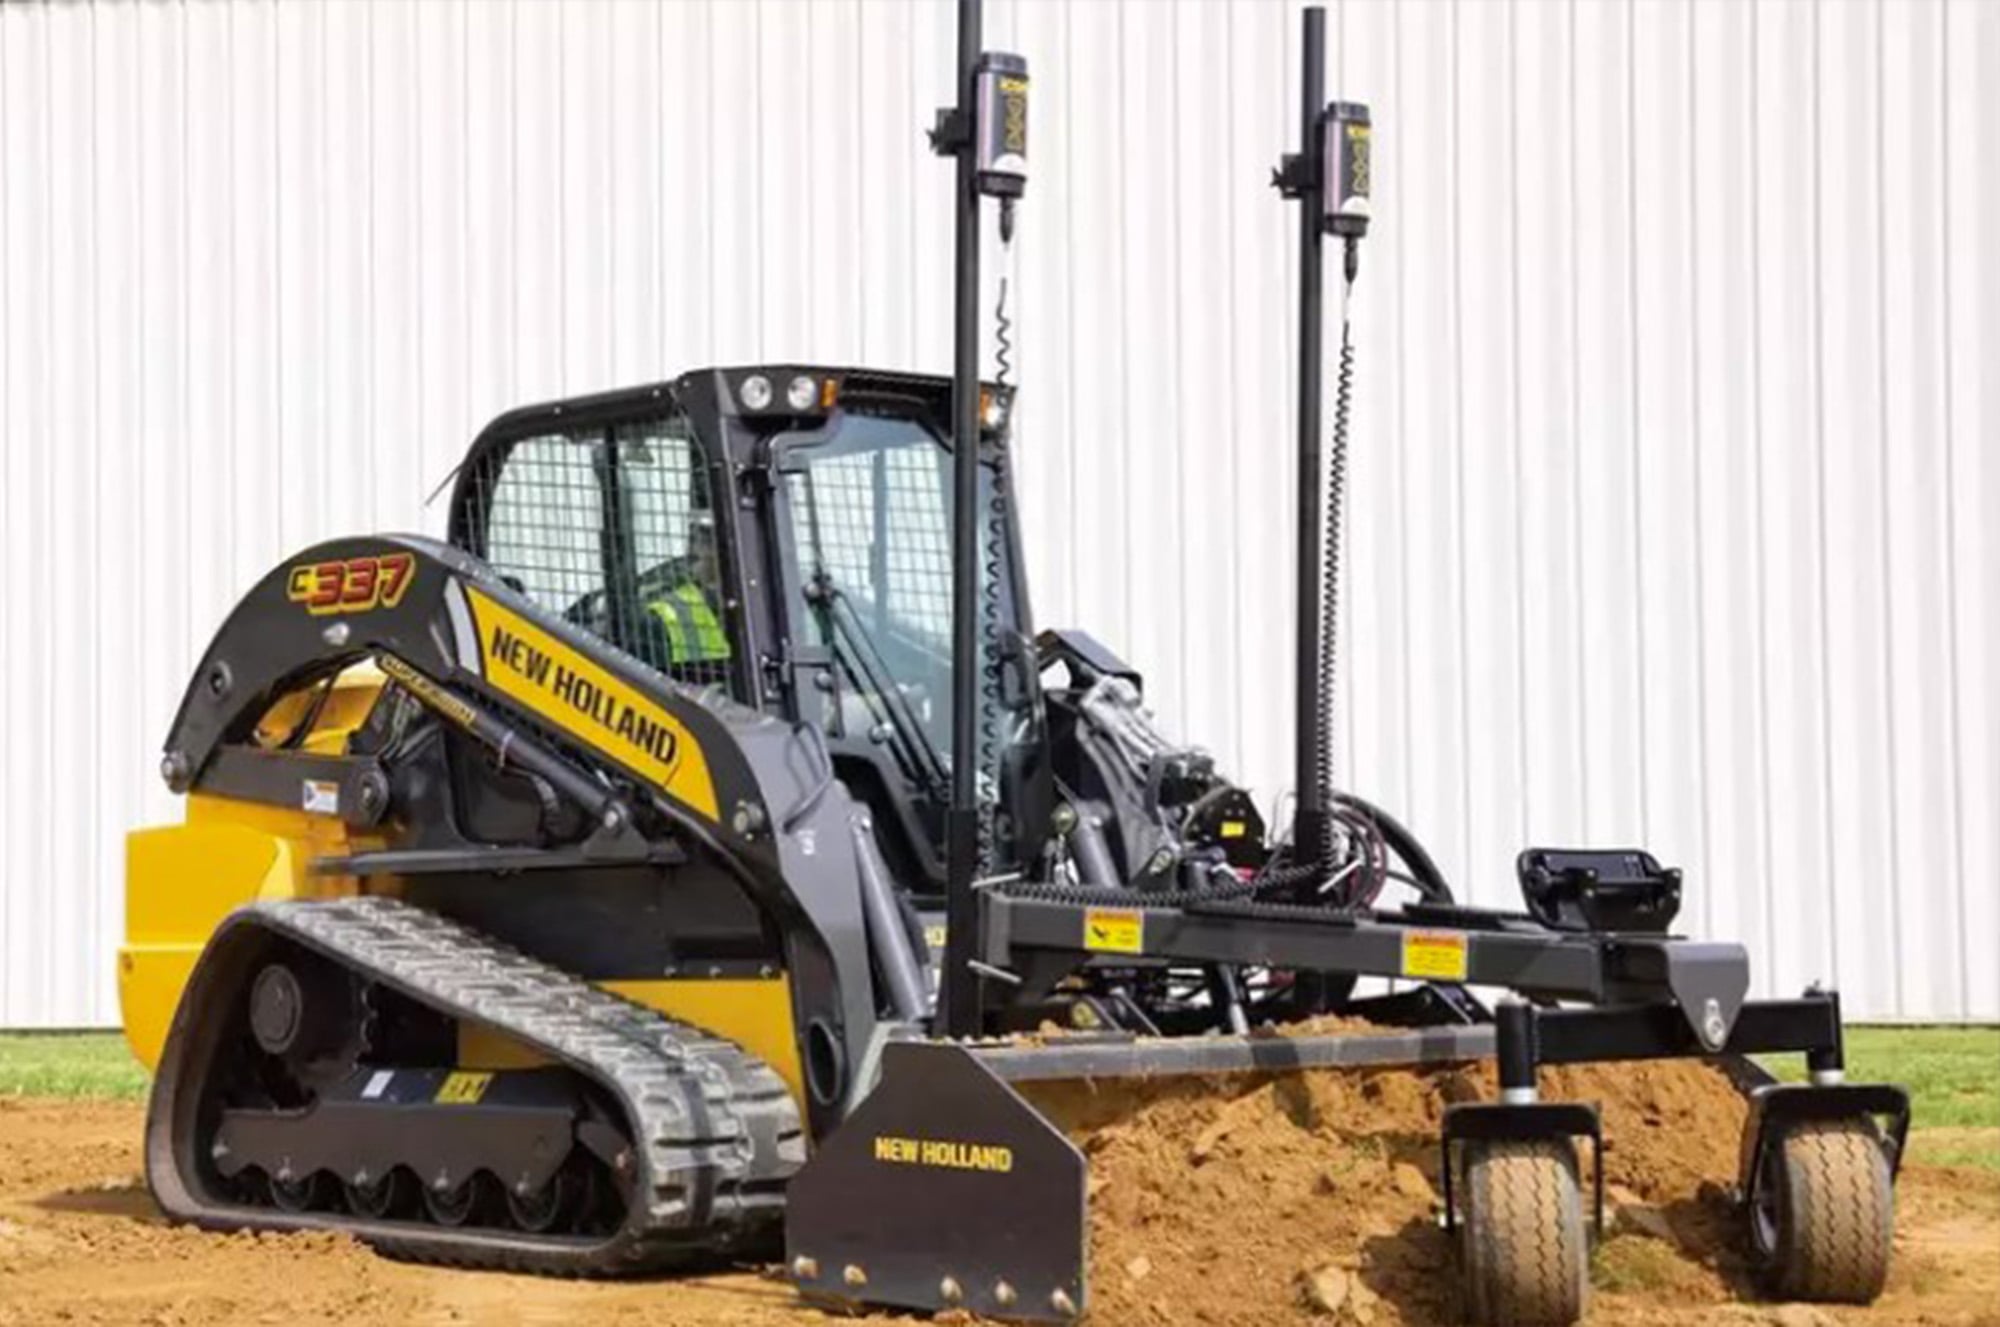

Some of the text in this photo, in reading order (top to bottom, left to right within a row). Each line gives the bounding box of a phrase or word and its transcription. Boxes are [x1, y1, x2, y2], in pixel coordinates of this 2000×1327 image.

[491, 625, 551, 687] NEW
[553, 664, 677, 765] HOLLAND
[875, 1136, 1012, 1172] NEW HOLLAND
